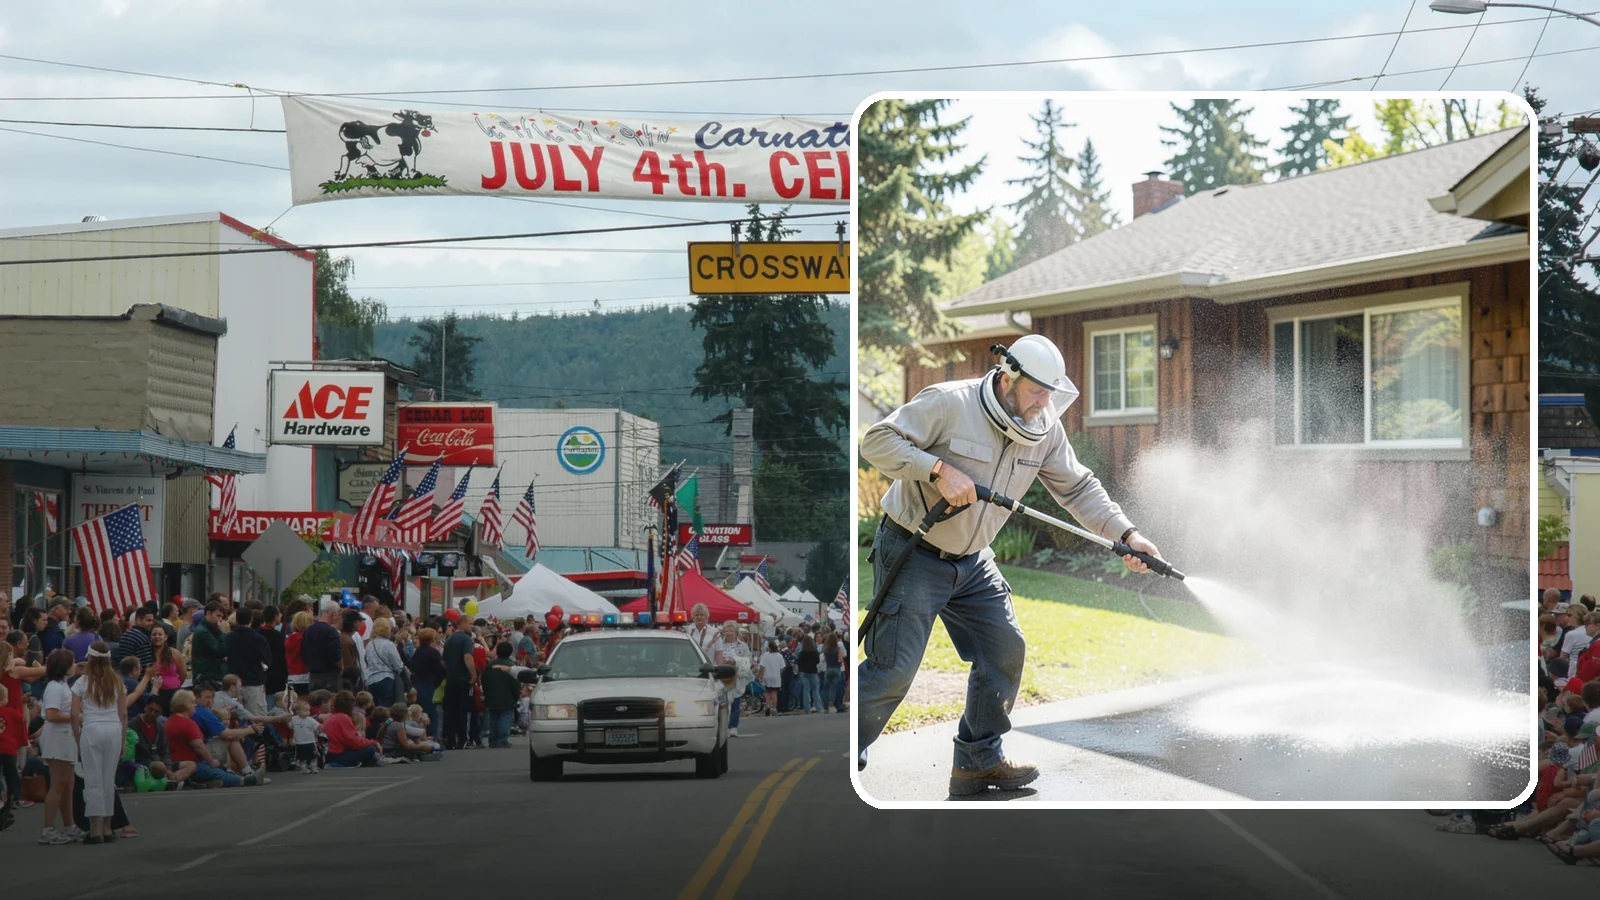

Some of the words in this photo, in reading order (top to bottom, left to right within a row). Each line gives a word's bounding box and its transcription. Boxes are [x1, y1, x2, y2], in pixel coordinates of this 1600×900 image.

[481, 141, 604, 193] JULY
[632, 150, 747, 198] 4th.
[697, 254, 850, 280] CROSSWA
[283, 380, 373, 420] ACE
[405, 409, 454, 422] CEDAR
[461, 410, 485, 422] LOG
[283, 421, 371, 437] Hardware
[416, 428, 477, 447] Coca-Cola
[83, 485, 94, 495] St.
[95, 485, 124, 495] Vincent
[126, 486, 136, 495] de
[137, 486, 155, 496] Paul
[688, 526, 741, 535] CRNATION
[699, 535, 730, 543] GLASS
